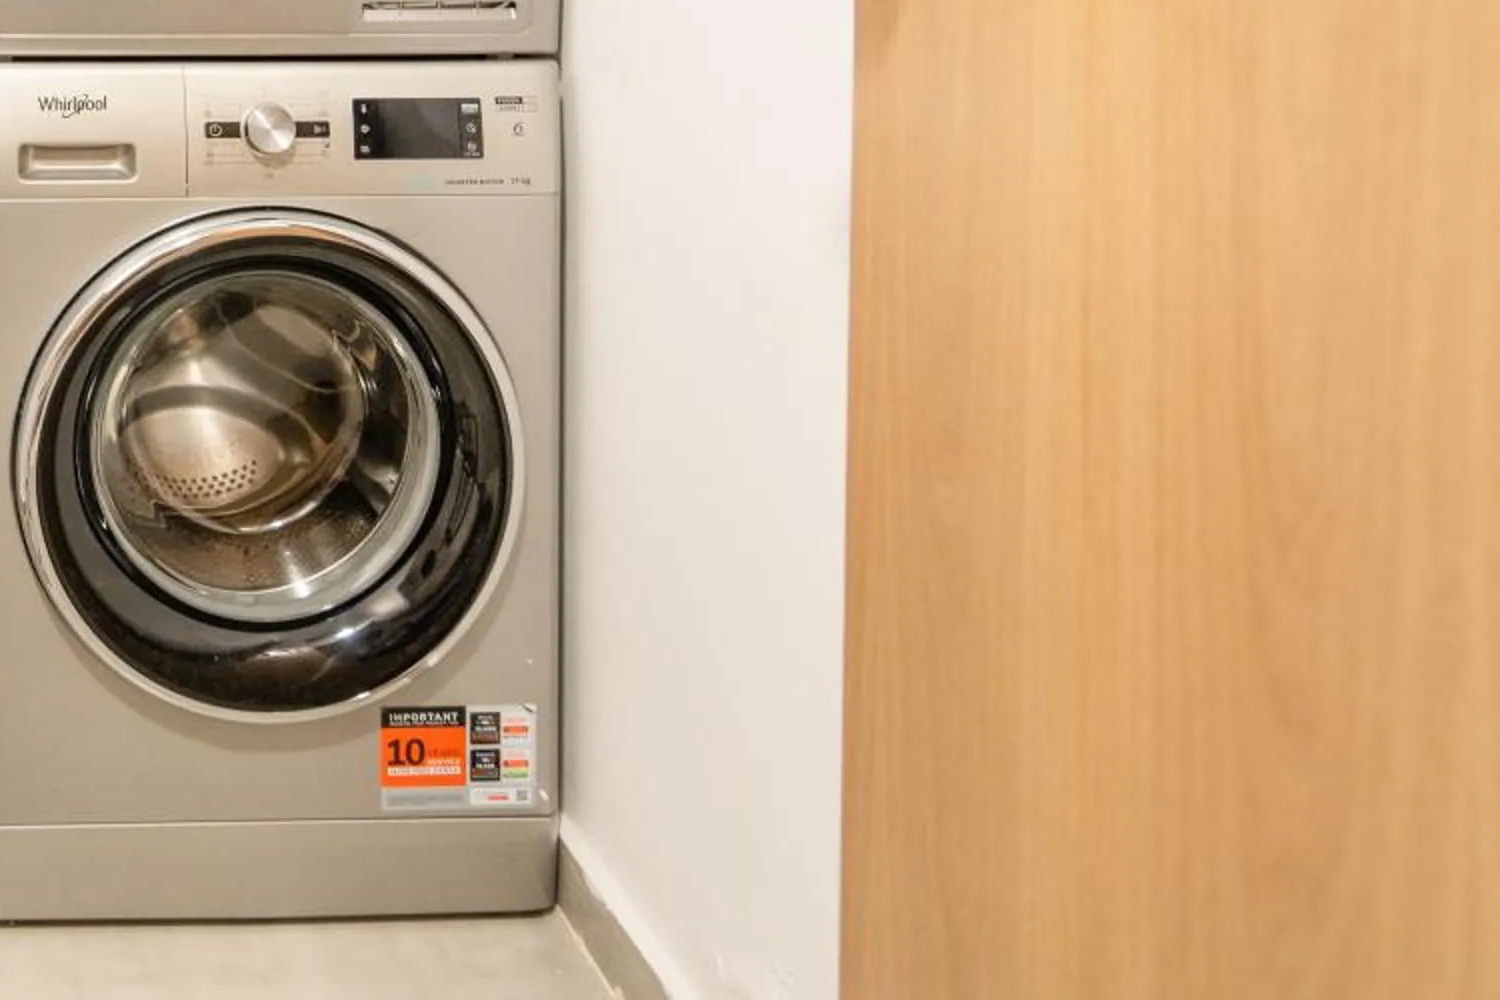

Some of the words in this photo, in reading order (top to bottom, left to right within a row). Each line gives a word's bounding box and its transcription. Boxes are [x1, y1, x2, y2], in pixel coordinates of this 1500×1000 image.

[37, 94, 108, 119] Whirlpool
[389, 711, 459, 722] IMPORTANT
[387, 738, 426, 767] 10
